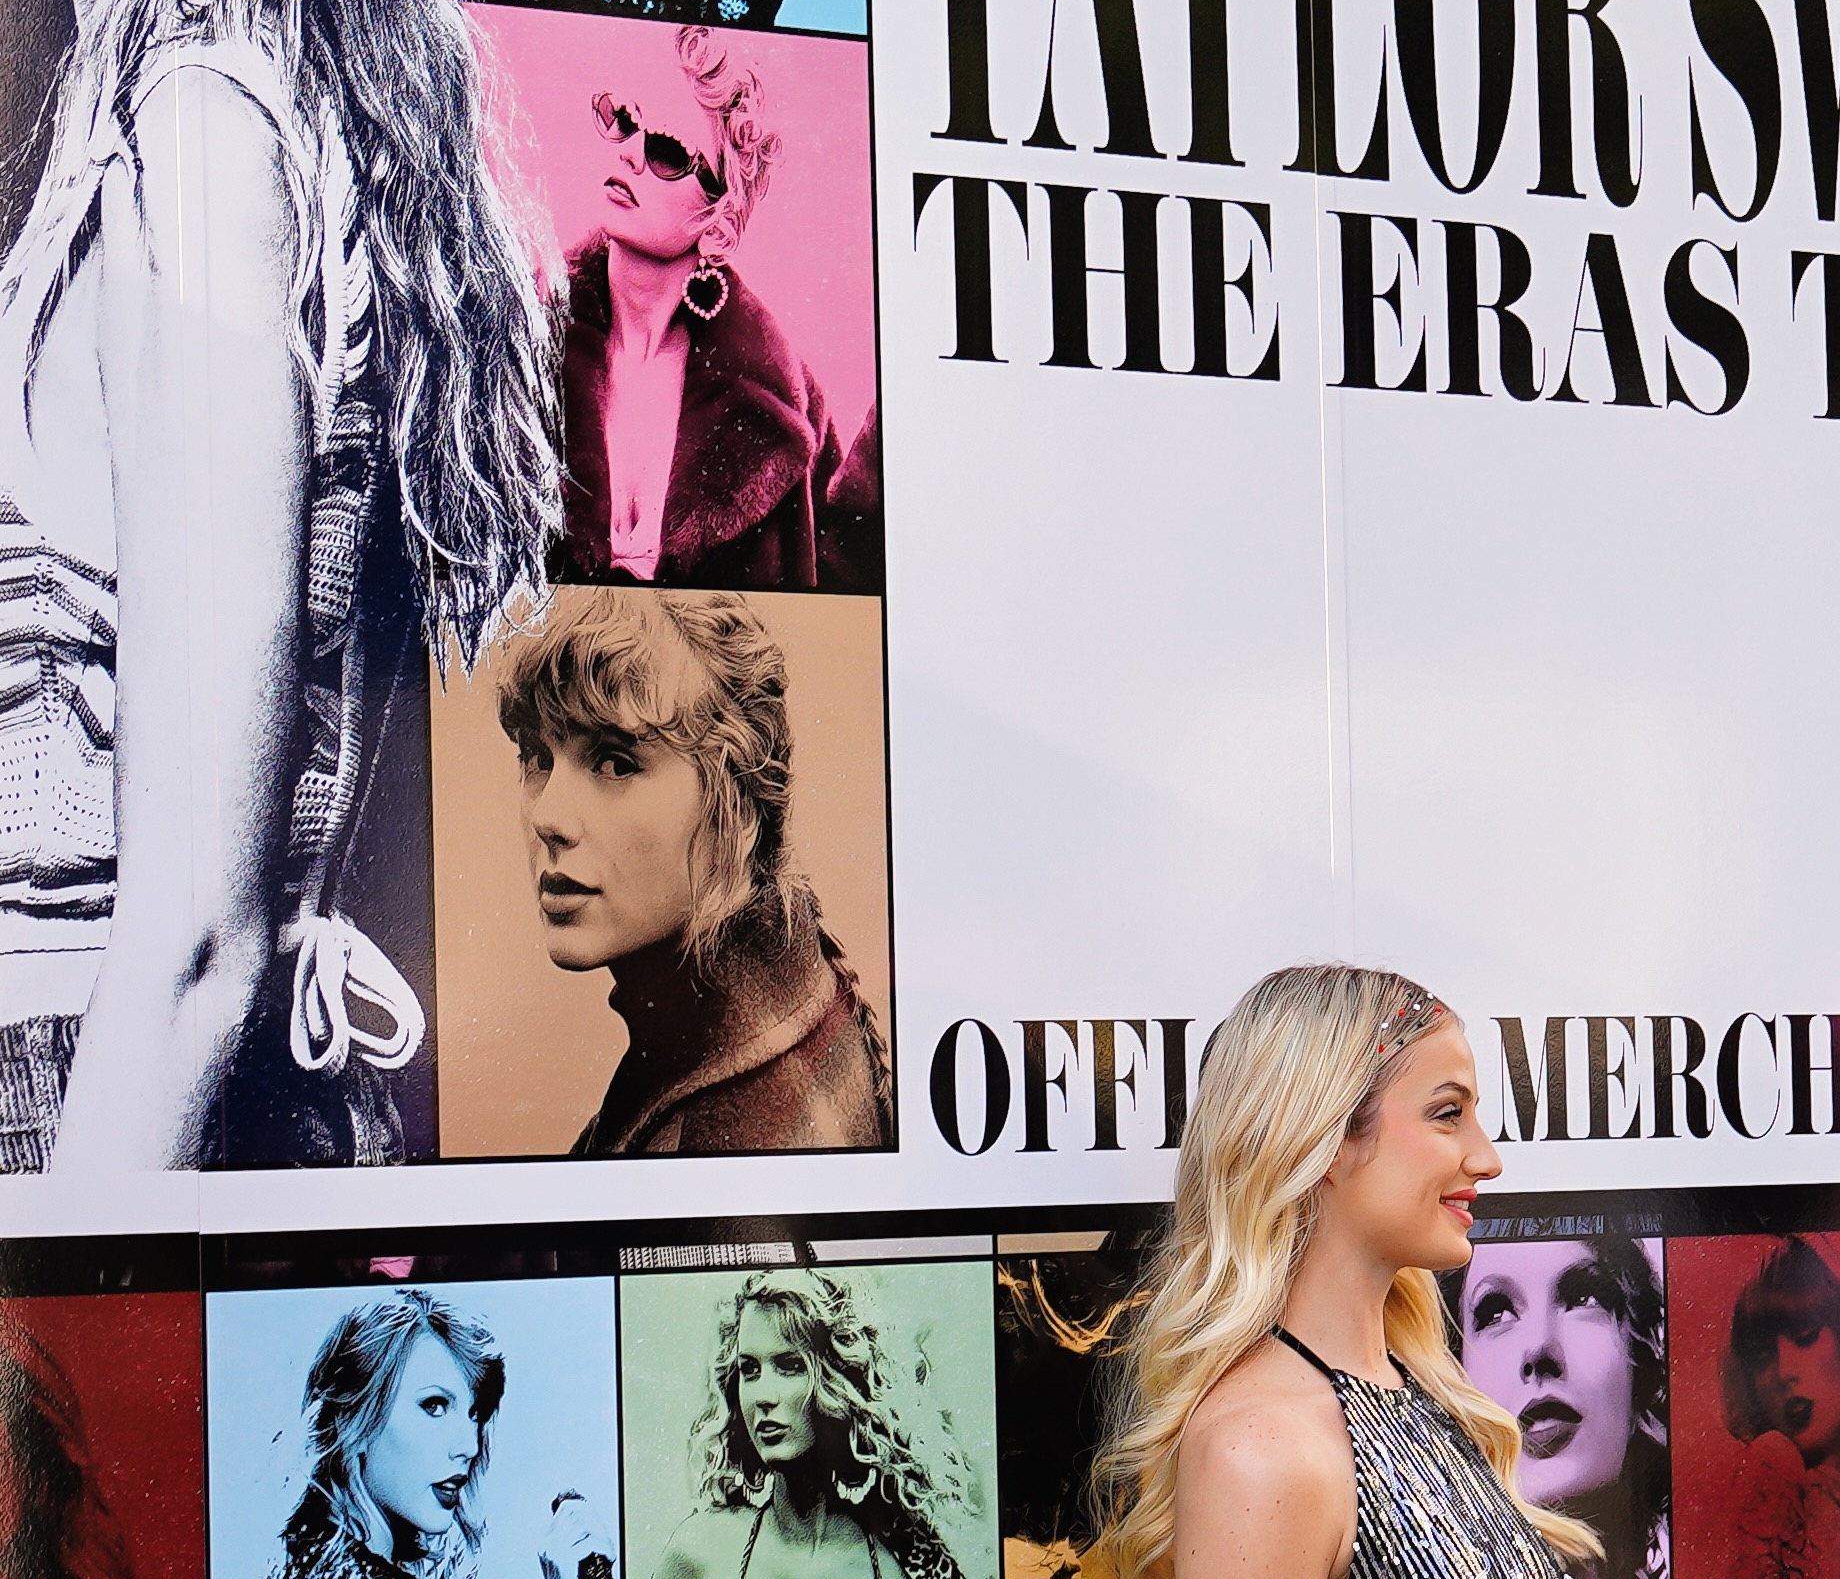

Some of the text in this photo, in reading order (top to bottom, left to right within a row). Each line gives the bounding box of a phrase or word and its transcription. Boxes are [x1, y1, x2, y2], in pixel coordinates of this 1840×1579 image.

[913, 173, 1280, 381] THE
[1326, 211, 1749, 415] ERAS
[930, 1019, 1221, 1156] OFFI
